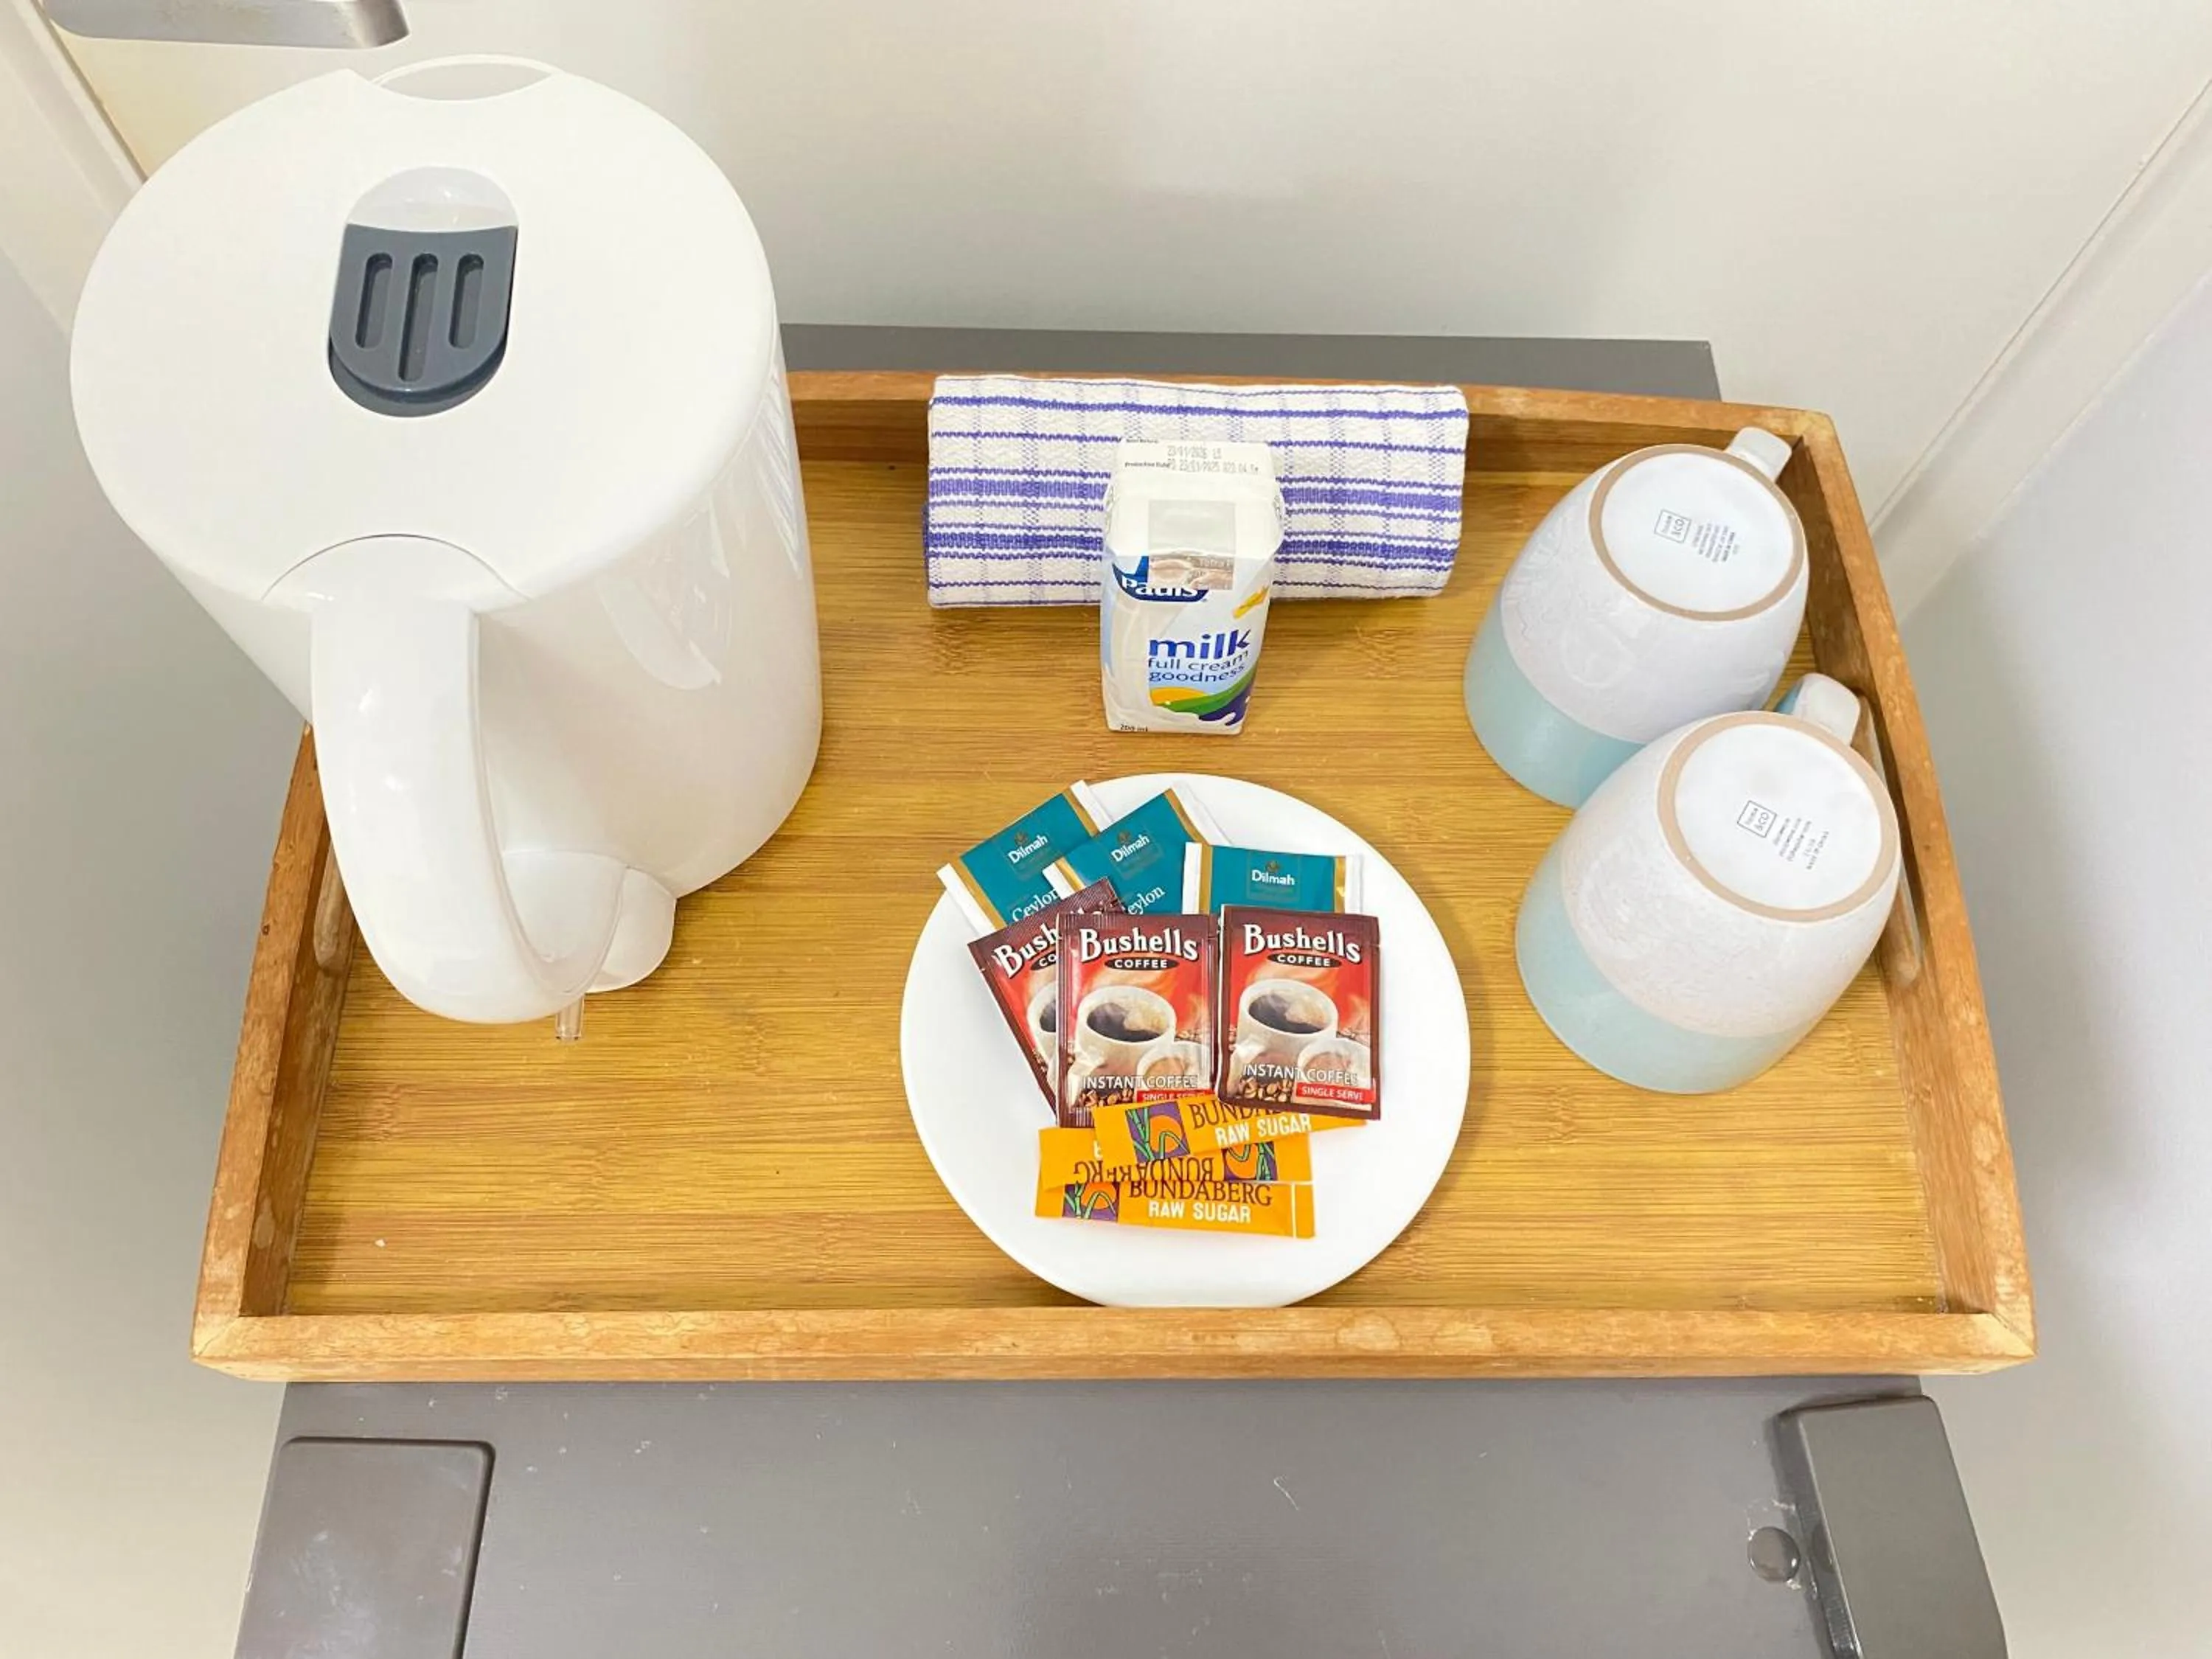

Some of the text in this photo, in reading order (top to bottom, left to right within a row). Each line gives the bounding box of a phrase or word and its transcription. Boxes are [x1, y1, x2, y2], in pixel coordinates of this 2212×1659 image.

[1148, 630, 1251, 659] milk
[1148, 650, 1248, 671] full cream
[1148, 664, 1245, 682] goodness
[1008, 835, 1048, 864] Dilmah
[1110, 834, 1150, 862] Dilmah
[1251, 869, 1295, 886] Dilmah
[1012, 888, 1060, 922] Ceylon
[1127, 886, 1166, 915] eylon
[994, 923, 1062, 978] Bush
[1079, 928, 1199, 963] Bushells
[1242, 924, 1361, 964] Bushells
[1114, 959, 1168, 969] COFFEE
[1277, 954, 1331, 967] COFFEE
[1083, 1075, 1199, 1089] INSTANT COFFEE
[1243, 1064, 1358, 1086] INSTANT COFFEE
[1301, 1086, 1364, 1100] SINGLE SERVE
[1216, 1113, 1312, 1148] RAW SUGAR
[1129, 1180, 1273, 1206] BUNDABERG
[1148, 1200, 1251, 1223] RAW SUGAR
